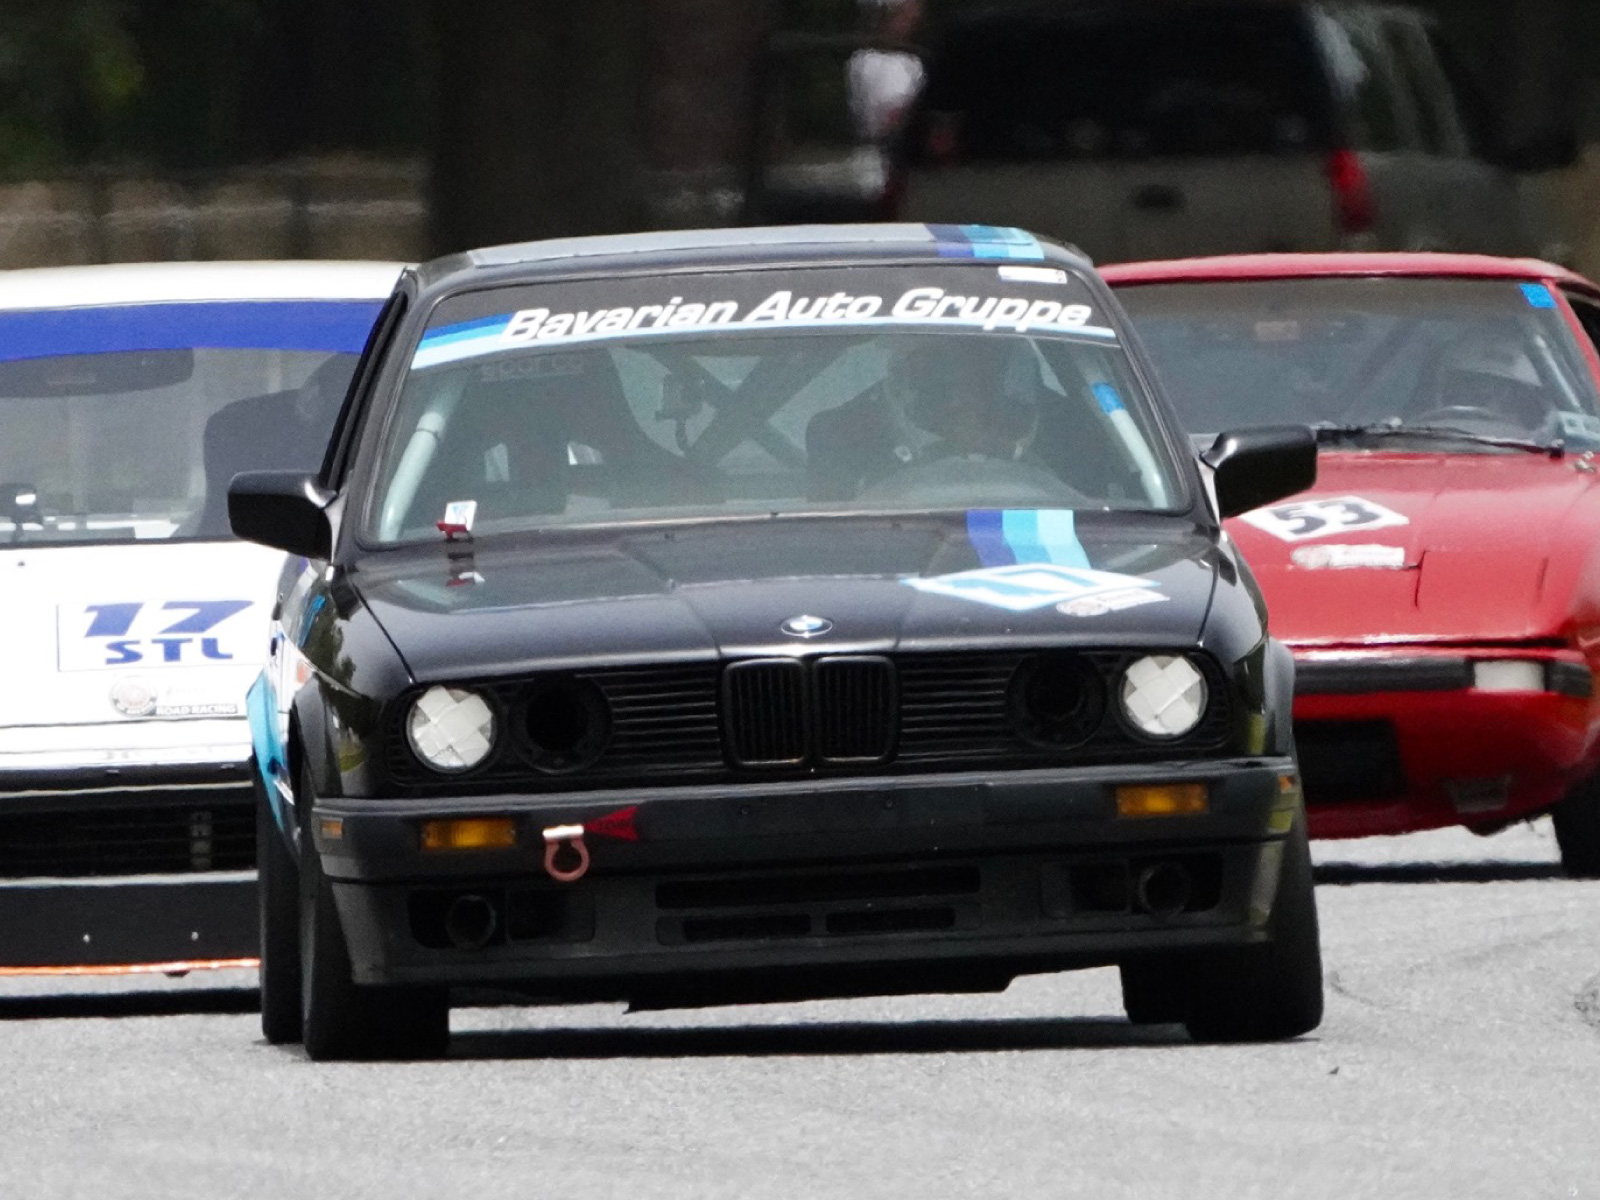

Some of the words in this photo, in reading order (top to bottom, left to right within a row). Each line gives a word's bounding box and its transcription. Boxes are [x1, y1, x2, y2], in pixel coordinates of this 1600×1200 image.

[503, 296, 739, 341] Bavarian
[743, 290, 883, 326] Auto
[892, 287, 1092, 331] Gruppe
[1269, 502, 1382, 535] 53
[83, 600, 255, 638] 17
[105, 637, 233, 665] STL
